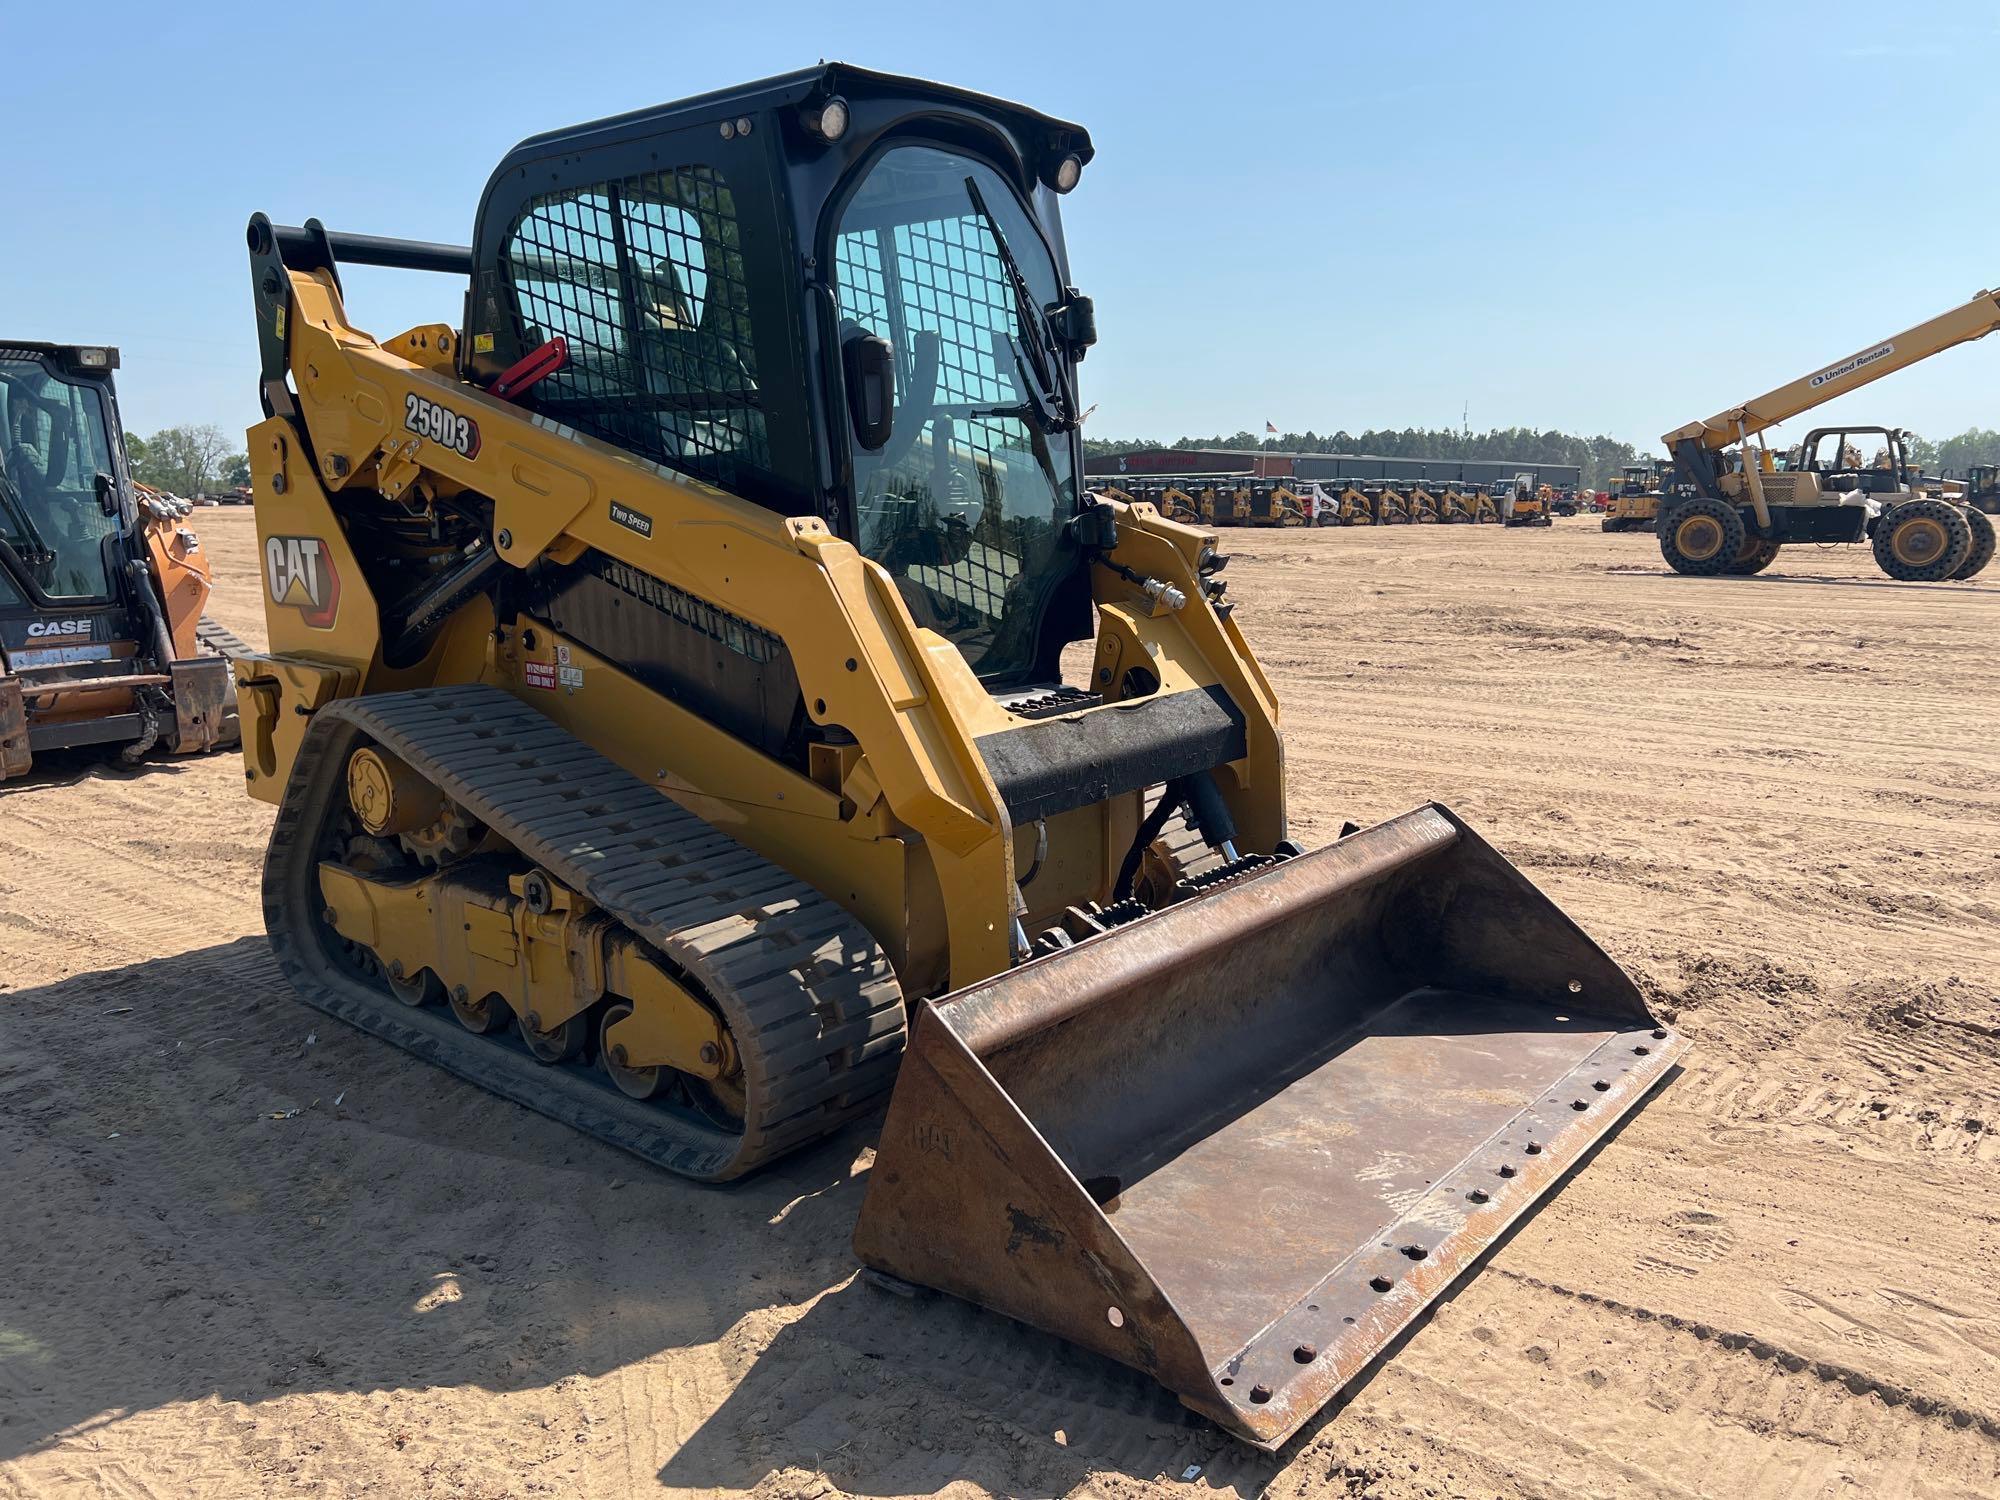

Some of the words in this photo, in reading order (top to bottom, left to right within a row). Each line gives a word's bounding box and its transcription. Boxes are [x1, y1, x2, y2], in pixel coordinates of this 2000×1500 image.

[1825, 362, 1855, 380] United
[1857, 347, 1890, 366] Rentals
[405, 394, 470, 455] 259D3
[266, 537, 320, 607] CAT
[27, 619, 92, 637] CASE
